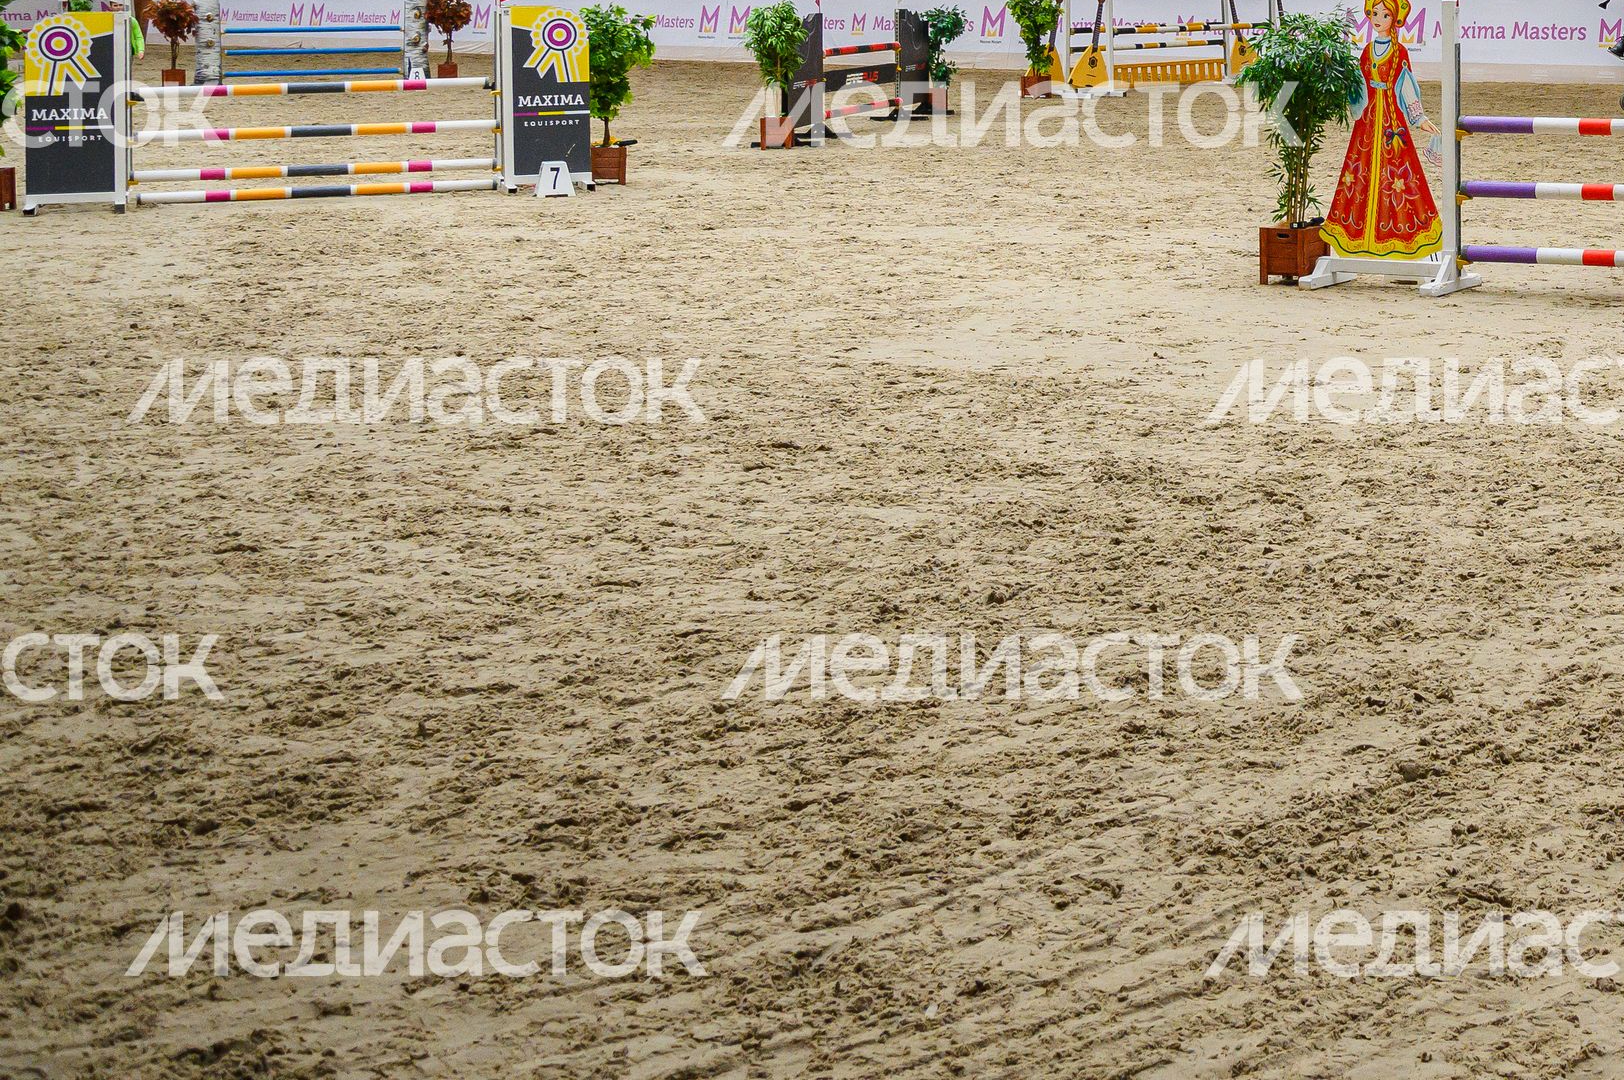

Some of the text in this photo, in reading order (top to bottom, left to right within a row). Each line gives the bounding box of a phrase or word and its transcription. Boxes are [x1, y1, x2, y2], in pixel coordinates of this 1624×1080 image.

[654, 14, 695, 29] Masters
[823, 17, 845, 30] ters
[1511, 21, 1587, 41] Masters
[518, 93, 585, 107] MAXIMA
[31, 107, 108, 121] MAXIMA
[523, 119, 580, 127] EQUISPORT
[38, 134, 103, 143] EQUISPORT
[550, 167, 560, 190] 7
